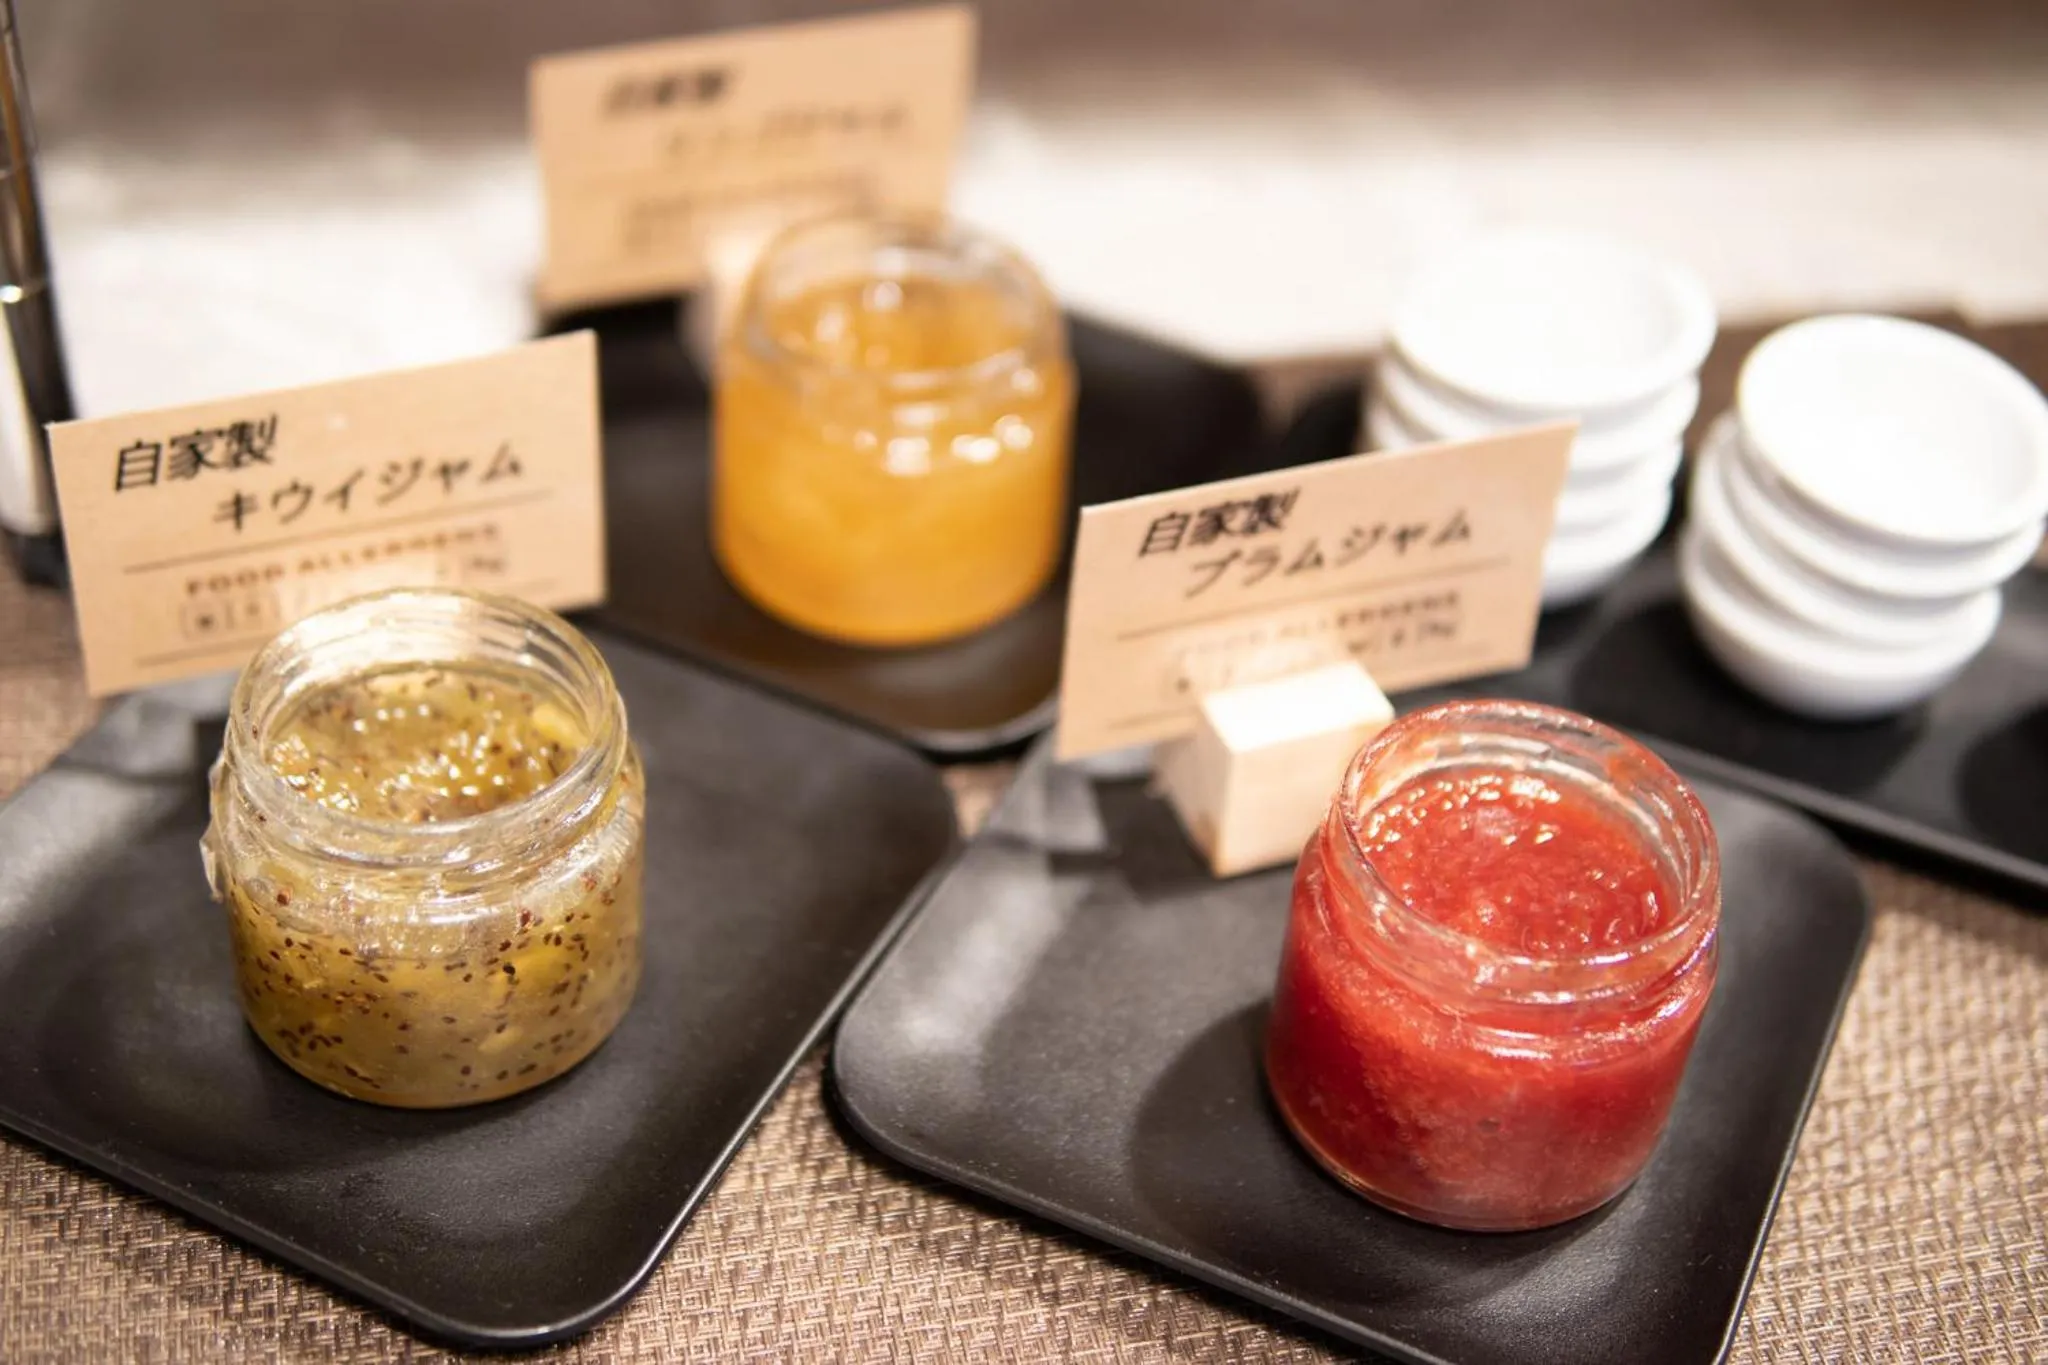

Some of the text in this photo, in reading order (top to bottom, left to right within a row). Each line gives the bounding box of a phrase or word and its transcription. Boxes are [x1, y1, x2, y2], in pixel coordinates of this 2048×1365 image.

[114, 413, 279, 492] 自家製
[212, 441, 523, 533] キウイジャム
[1138, 485, 1302, 559] 自家製
